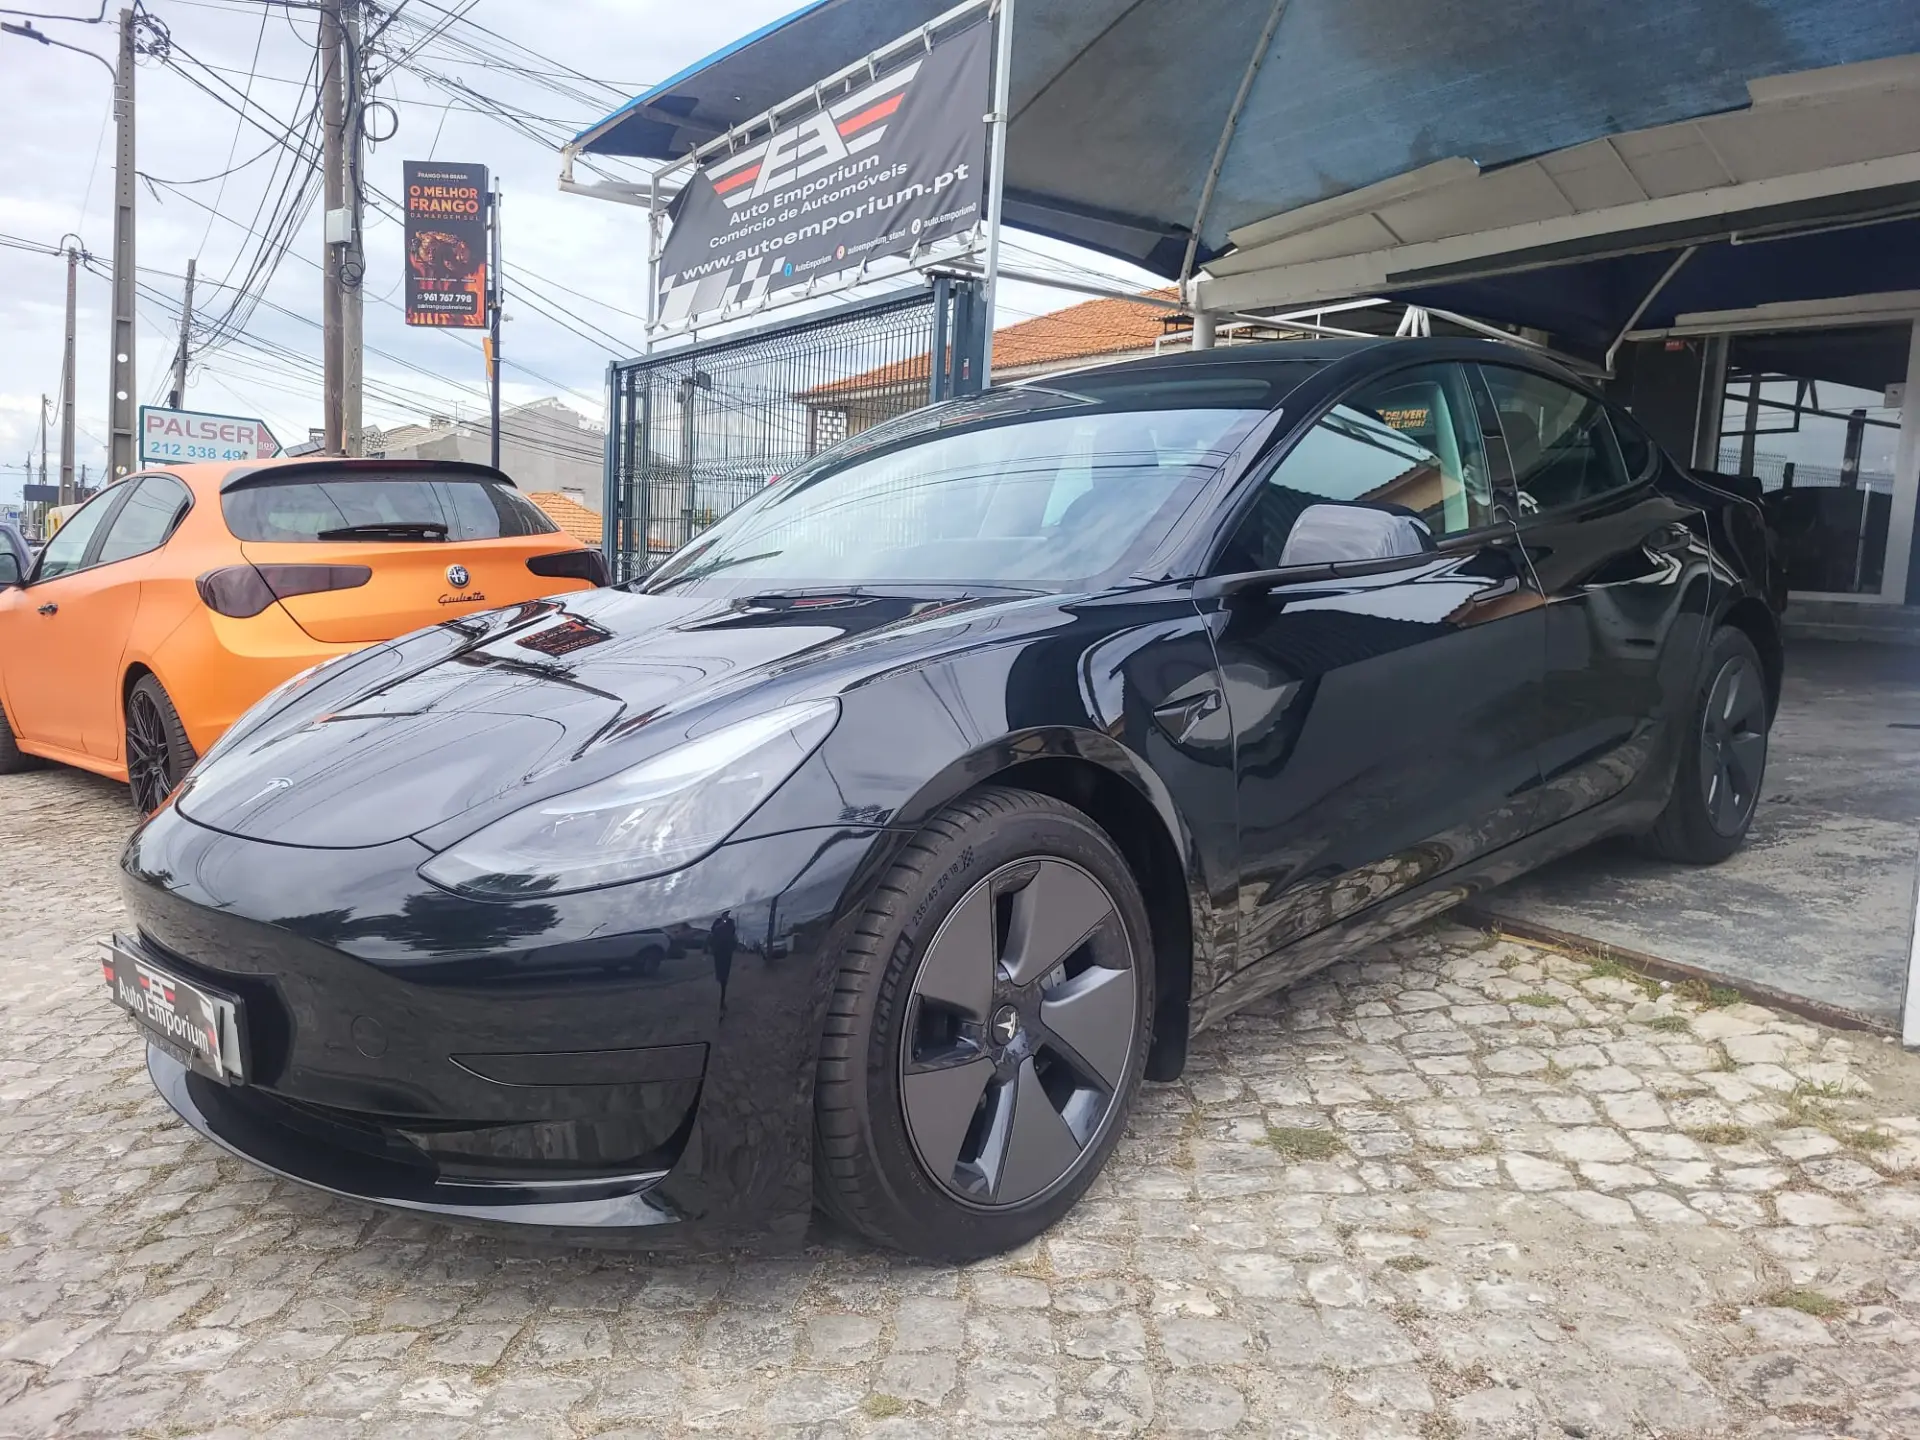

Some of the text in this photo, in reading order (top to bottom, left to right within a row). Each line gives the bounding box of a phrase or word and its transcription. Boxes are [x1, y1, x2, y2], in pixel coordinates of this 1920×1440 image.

[410, 185, 478, 199] O MELHOR
[729, 154, 880, 226] Auto Emporium
[409, 198, 479, 213] FRANGO
[709, 163, 908, 248] Comércio de Automóveis
[682, 163, 969, 280] www.autoemporium.pt
[423, 293, 472, 303] 961 767 798
[146, 415, 255, 445] PALSER
[150, 441, 248, 461] 212 338 49
[438, 591, 486, 606] Giulietta
[912, 863, 959, 927] 235/45 ZR 18
[118, 976, 144, 1013] Auto
[145, 989, 210, 1054] Emporium
